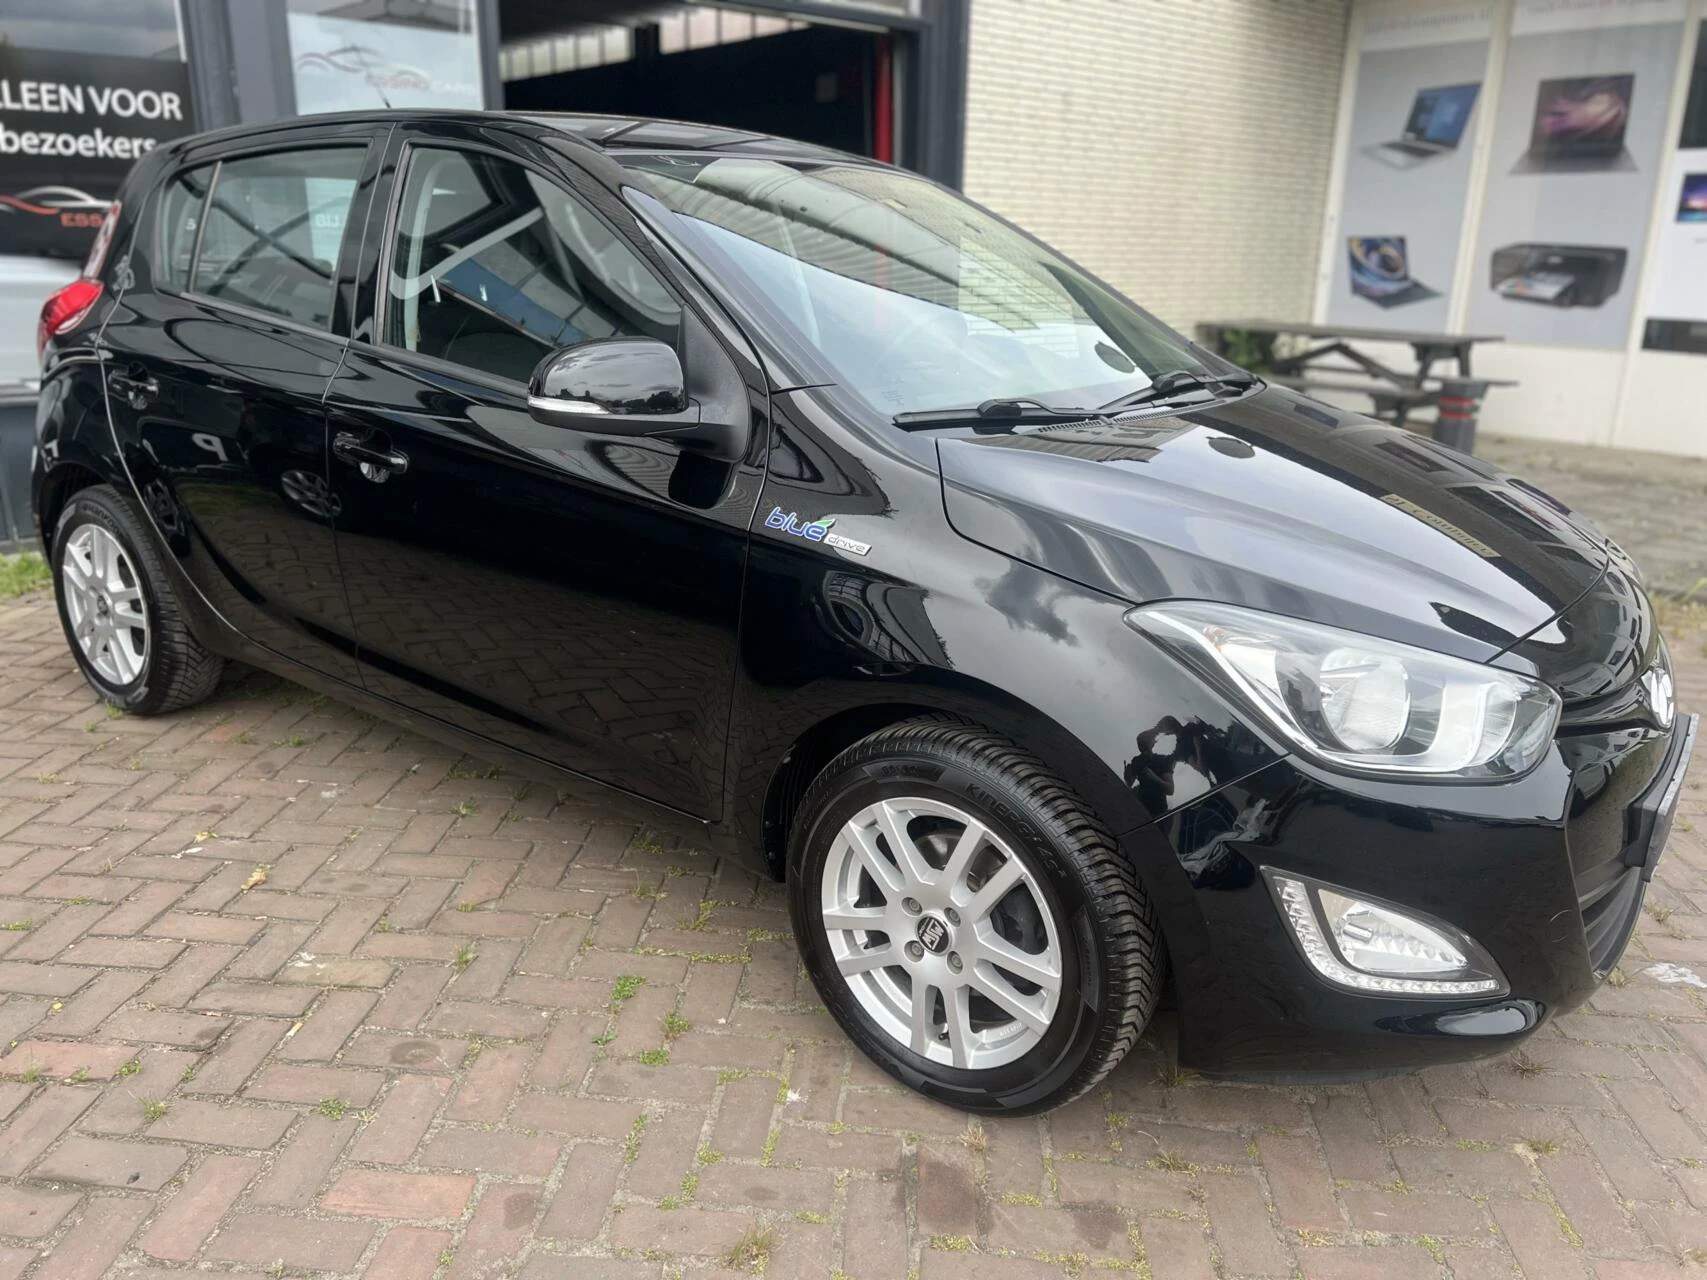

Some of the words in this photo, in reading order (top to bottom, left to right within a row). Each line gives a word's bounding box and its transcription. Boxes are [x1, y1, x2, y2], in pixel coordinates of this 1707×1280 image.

[0, 79, 85, 115] LEEN
[87, 85, 183, 121] VOOR
[0, 122, 157, 159] bezoekers
[765, 506, 828, 542] blue
[828, 535, 866, 552] drive
